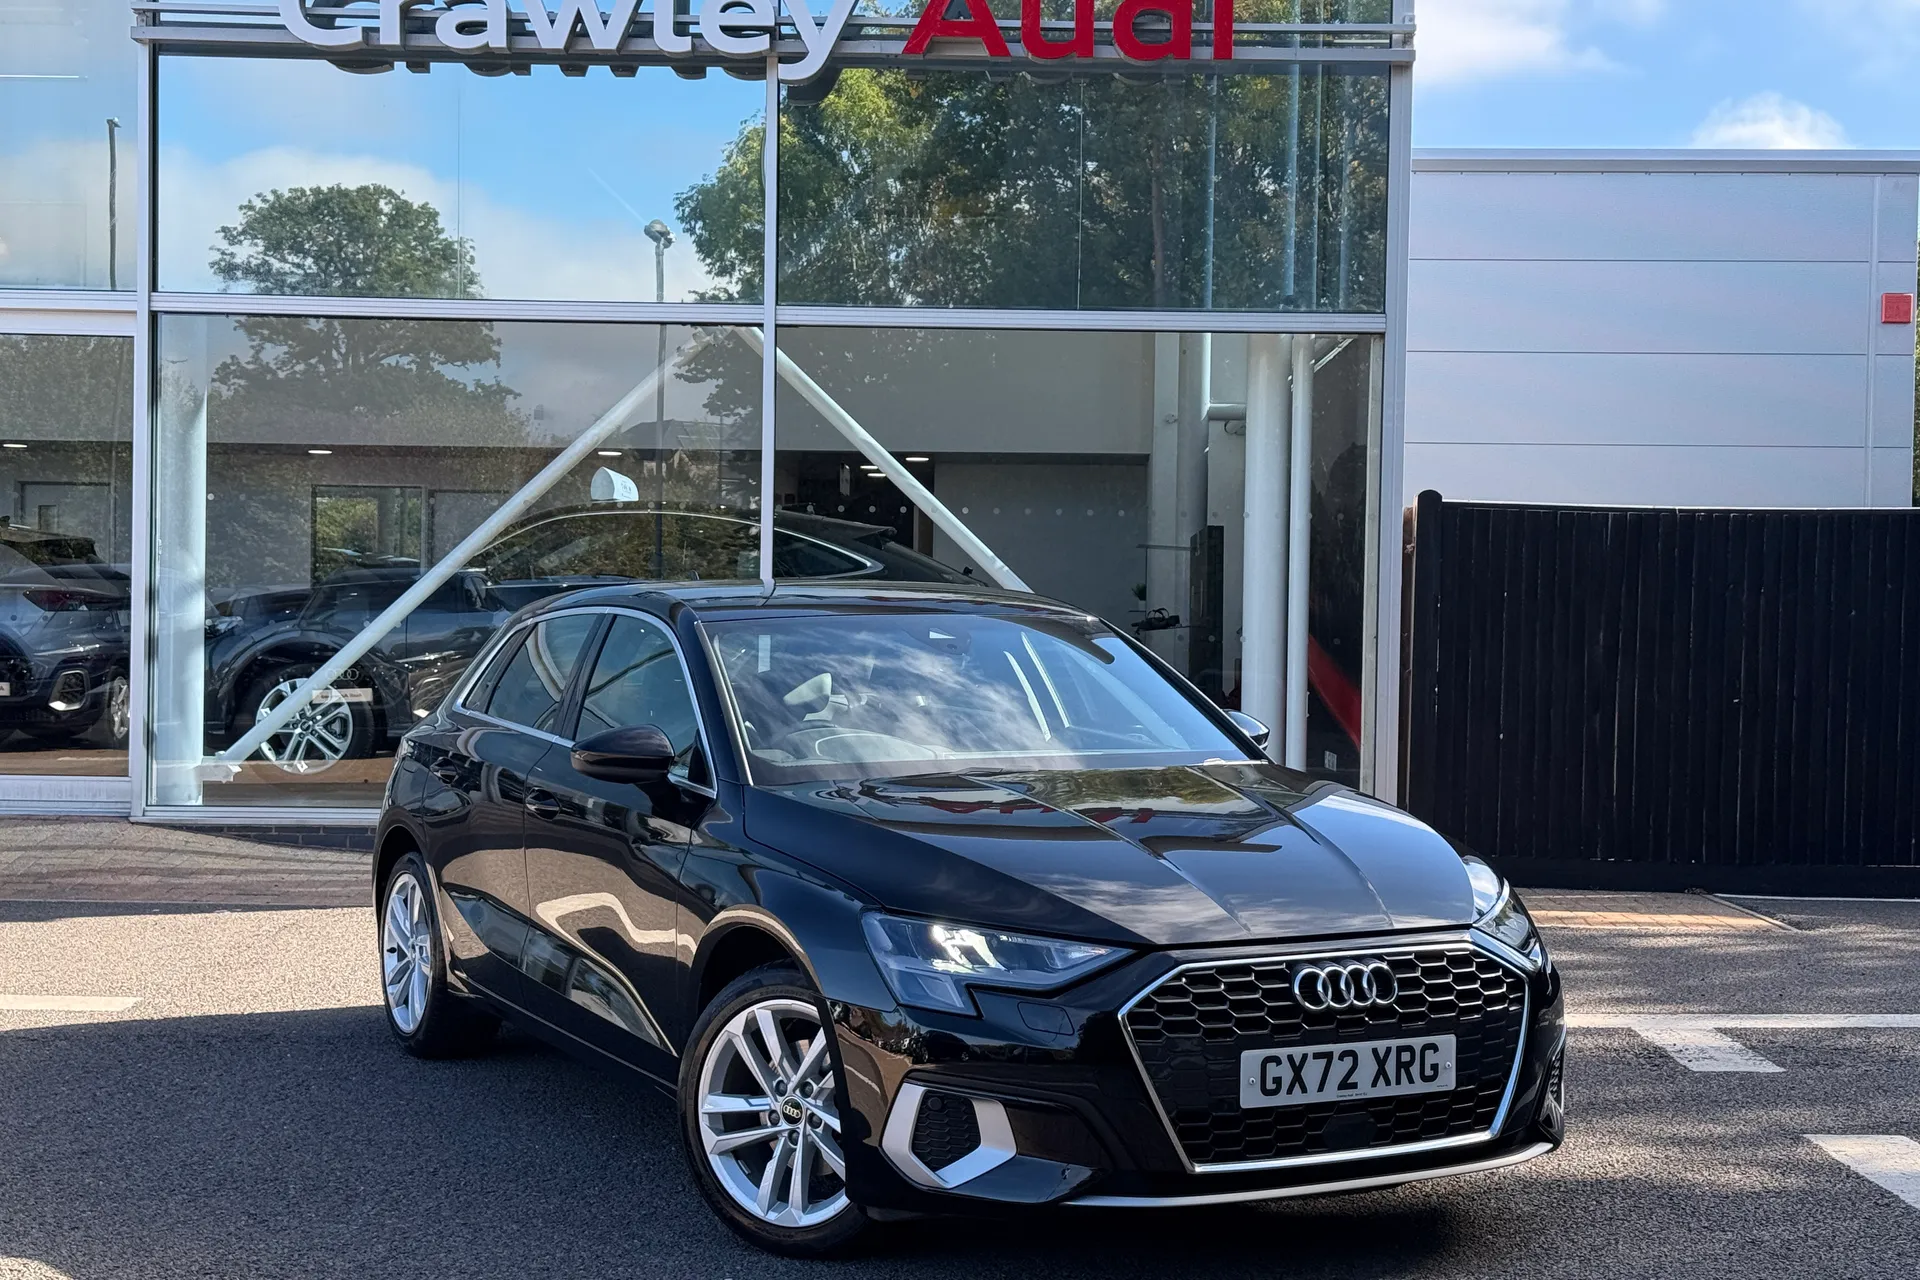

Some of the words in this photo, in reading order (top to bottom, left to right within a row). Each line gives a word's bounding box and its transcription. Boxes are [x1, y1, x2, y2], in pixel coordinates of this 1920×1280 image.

[279, 0, 857, 81] Crawley
[901, 0, 1234, 60] Audi
[1260, 1049, 1359, 1097] GX72
[1370, 1042, 1440, 1088] XRG
